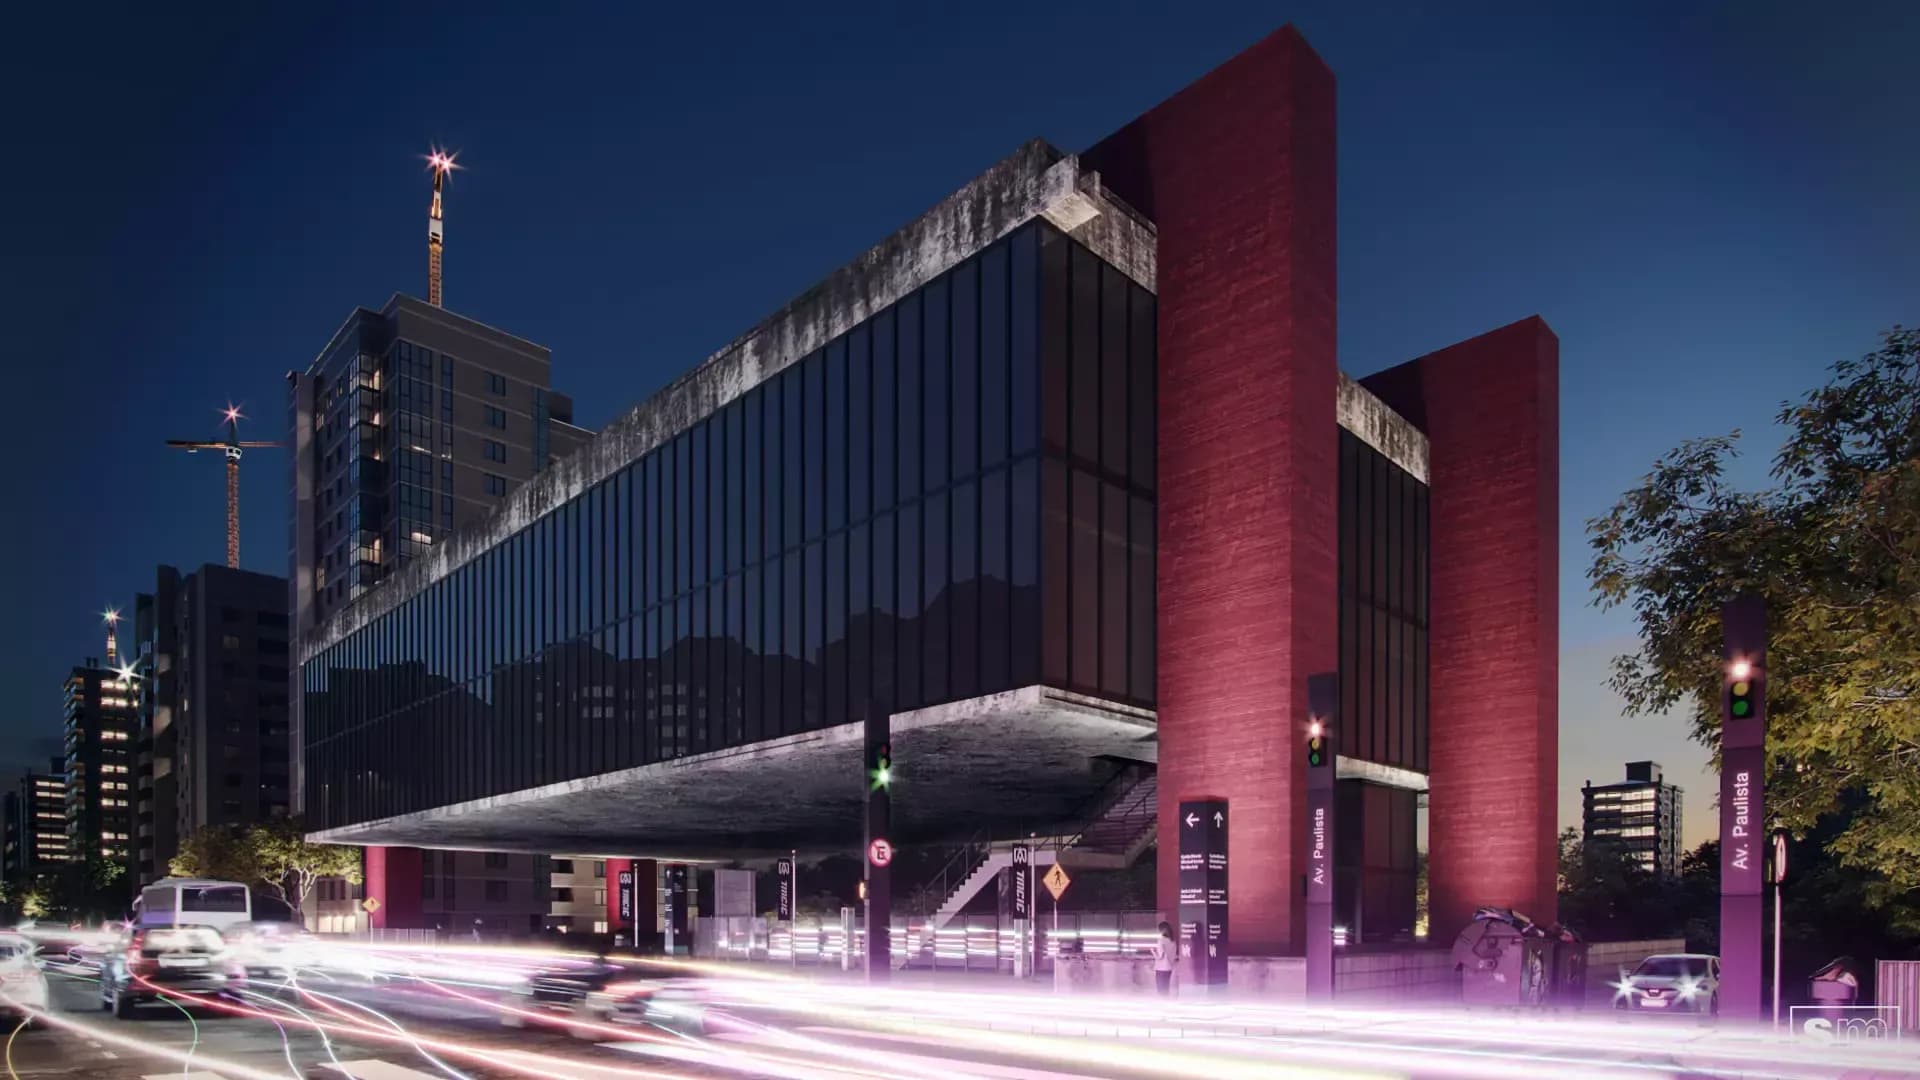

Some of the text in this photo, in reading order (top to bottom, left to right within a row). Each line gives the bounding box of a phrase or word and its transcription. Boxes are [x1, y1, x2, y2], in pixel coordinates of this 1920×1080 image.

[1313, 807, 1324, 885] Av. Paulista
[1732, 772, 1749, 870] Av. Paulista
